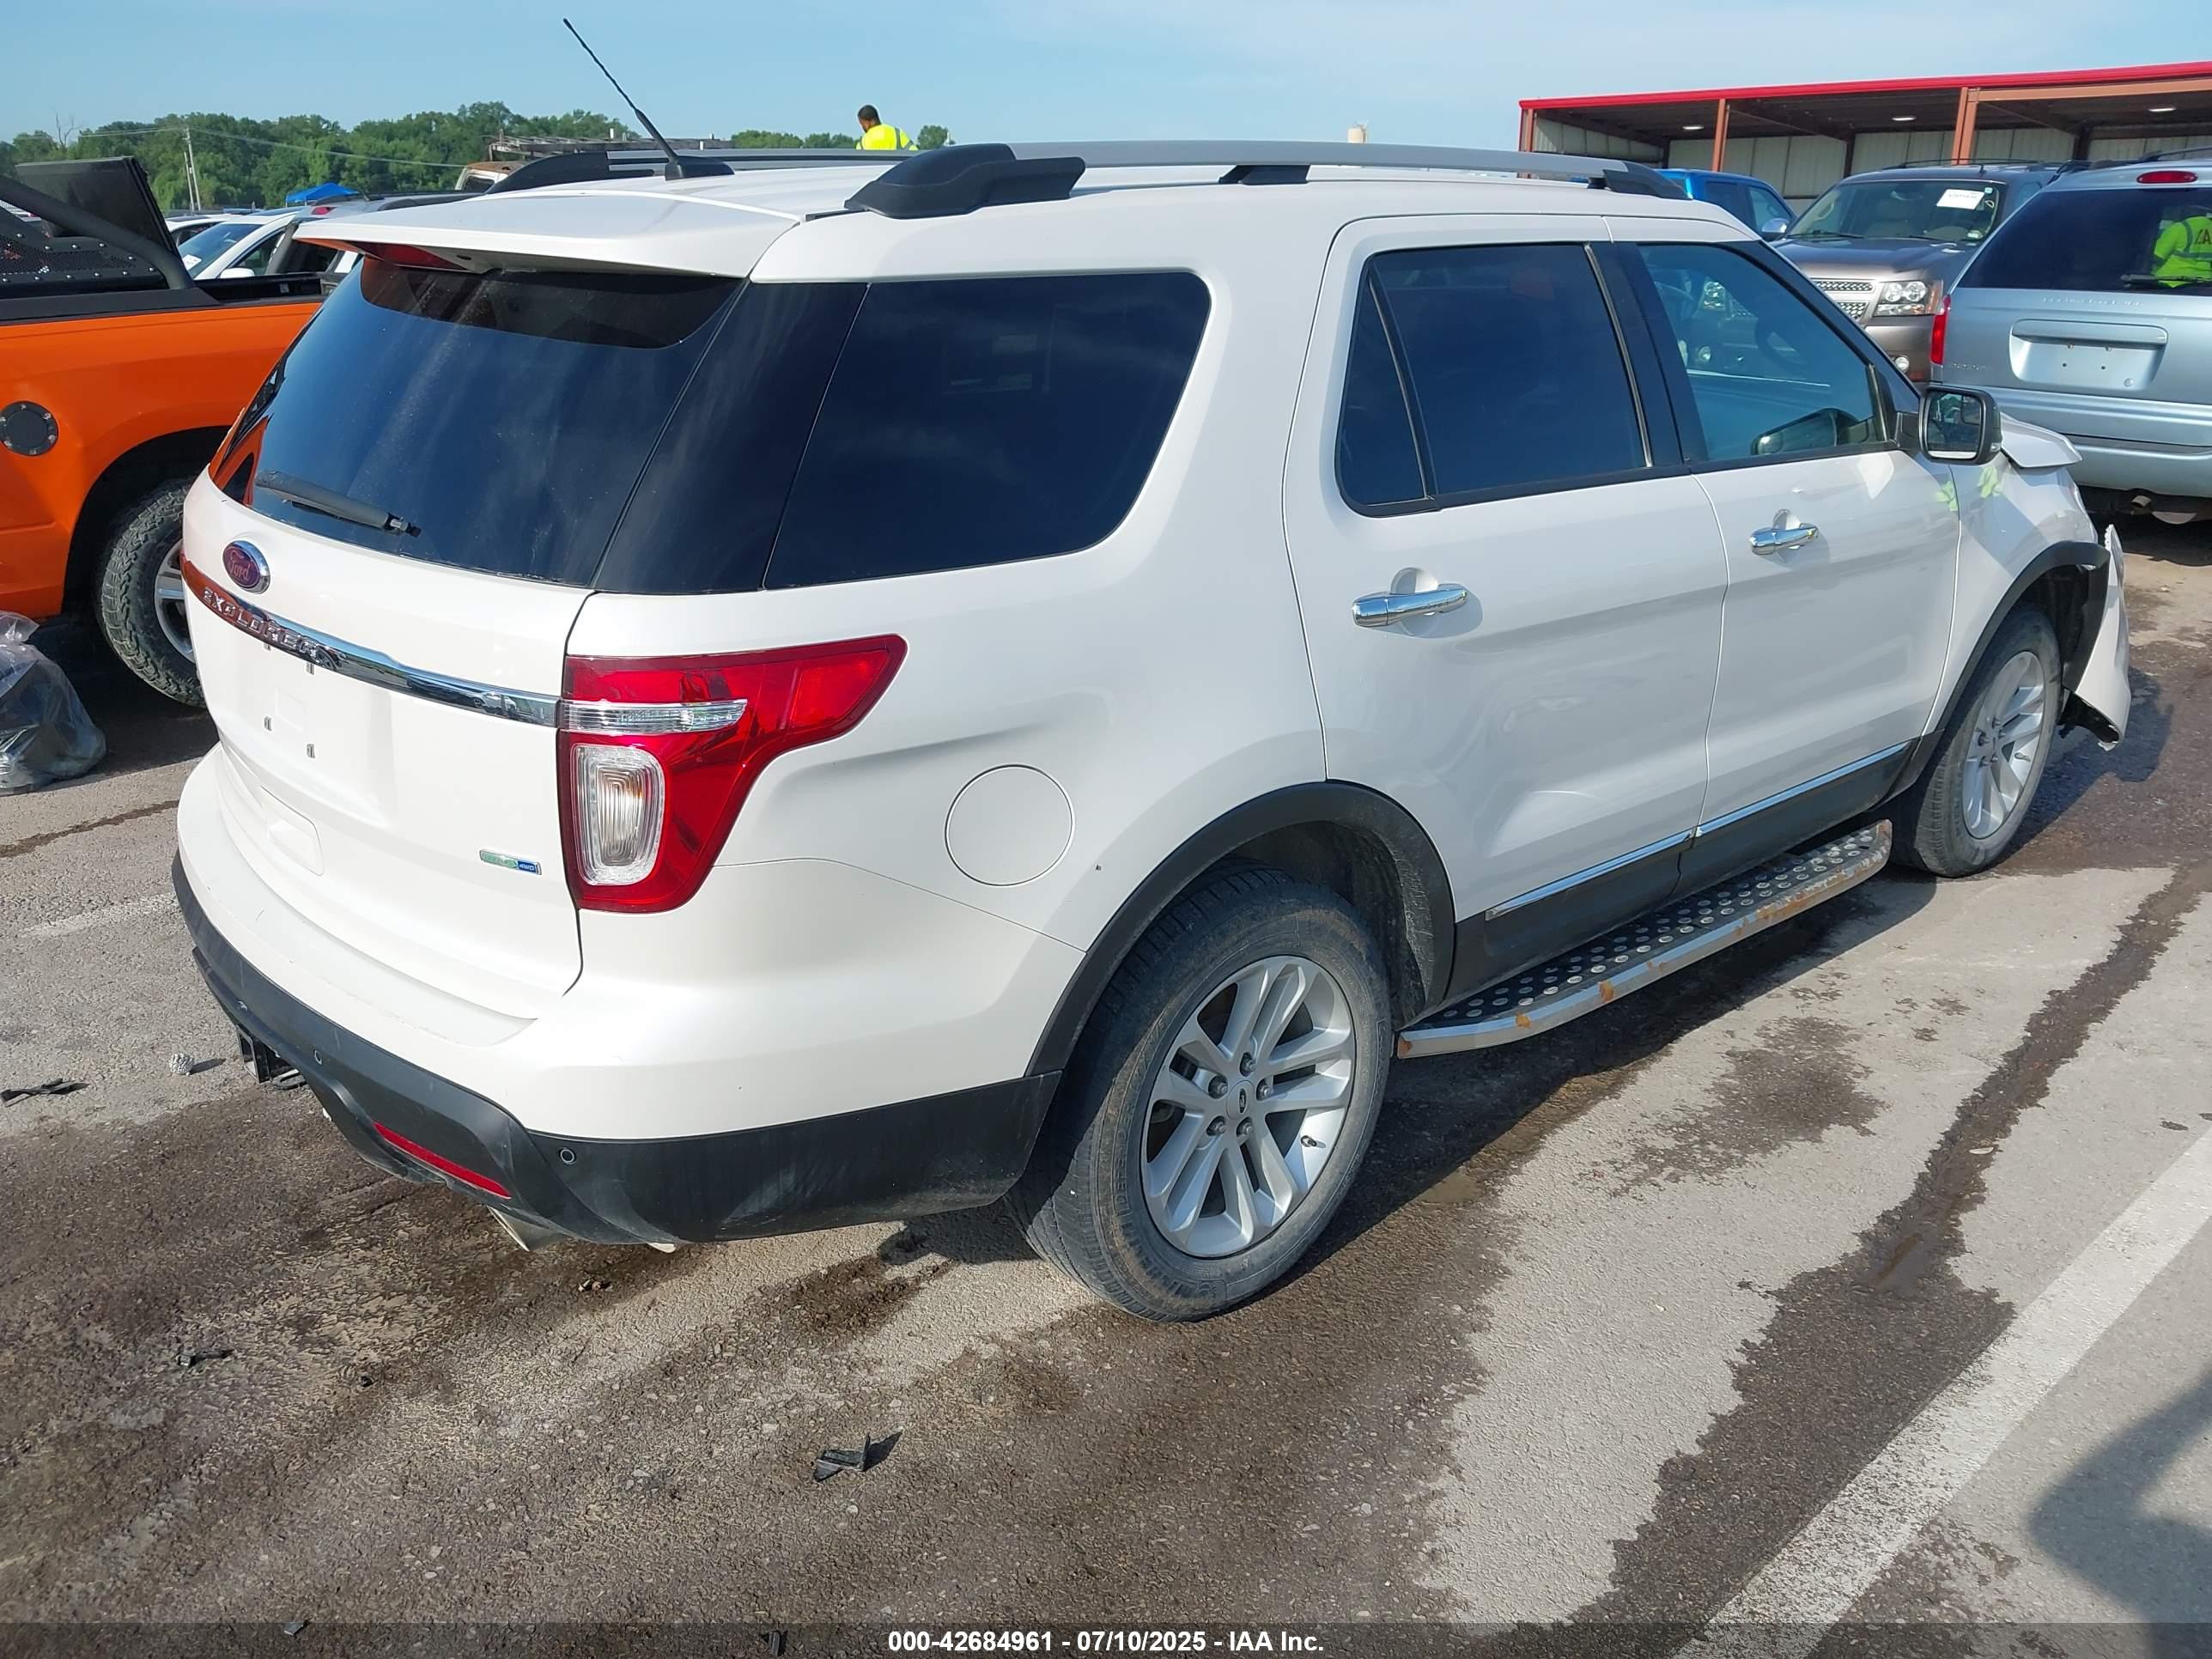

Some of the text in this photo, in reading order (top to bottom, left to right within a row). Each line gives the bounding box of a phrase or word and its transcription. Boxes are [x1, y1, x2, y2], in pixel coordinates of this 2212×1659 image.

[228, 549, 252, 581] Ford
[202, 586, 319, 661] EXPLORER
[519, 862, 535, 871] 4WD
